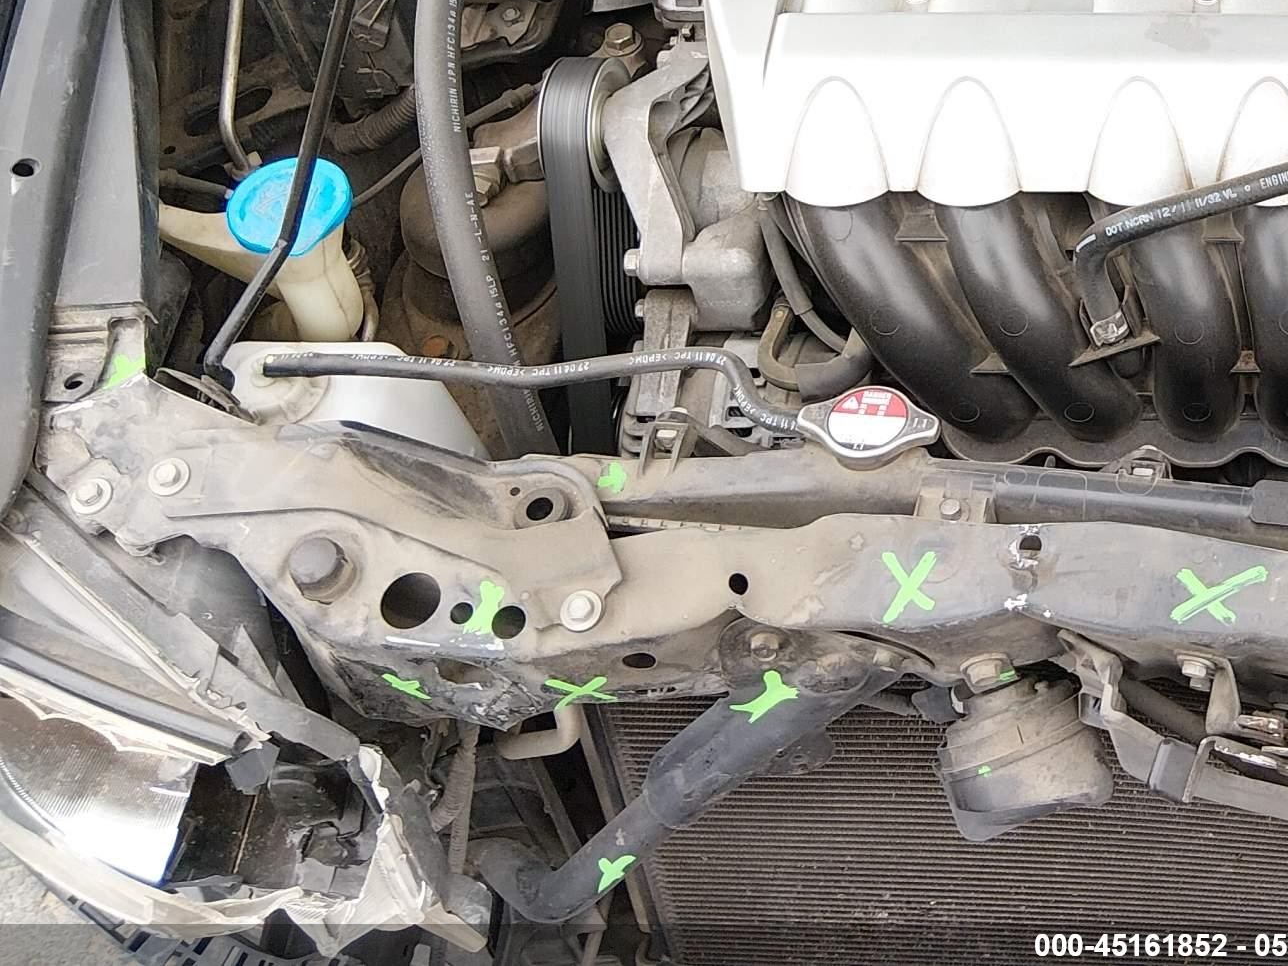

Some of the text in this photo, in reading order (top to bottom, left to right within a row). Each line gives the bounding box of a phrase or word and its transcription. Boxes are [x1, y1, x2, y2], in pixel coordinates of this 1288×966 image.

[447, 11, 458, 63] HFC134a
[449, 87, 462, 133] NICHIRIN
[1105, 224, 1124, 237] DOT
[1125, 211, 1155, 230] NCRN
[532, 368, 550, 376] TPC
[577, 362, 590, 372] 27
[759, 412, 778, 426] TPC
